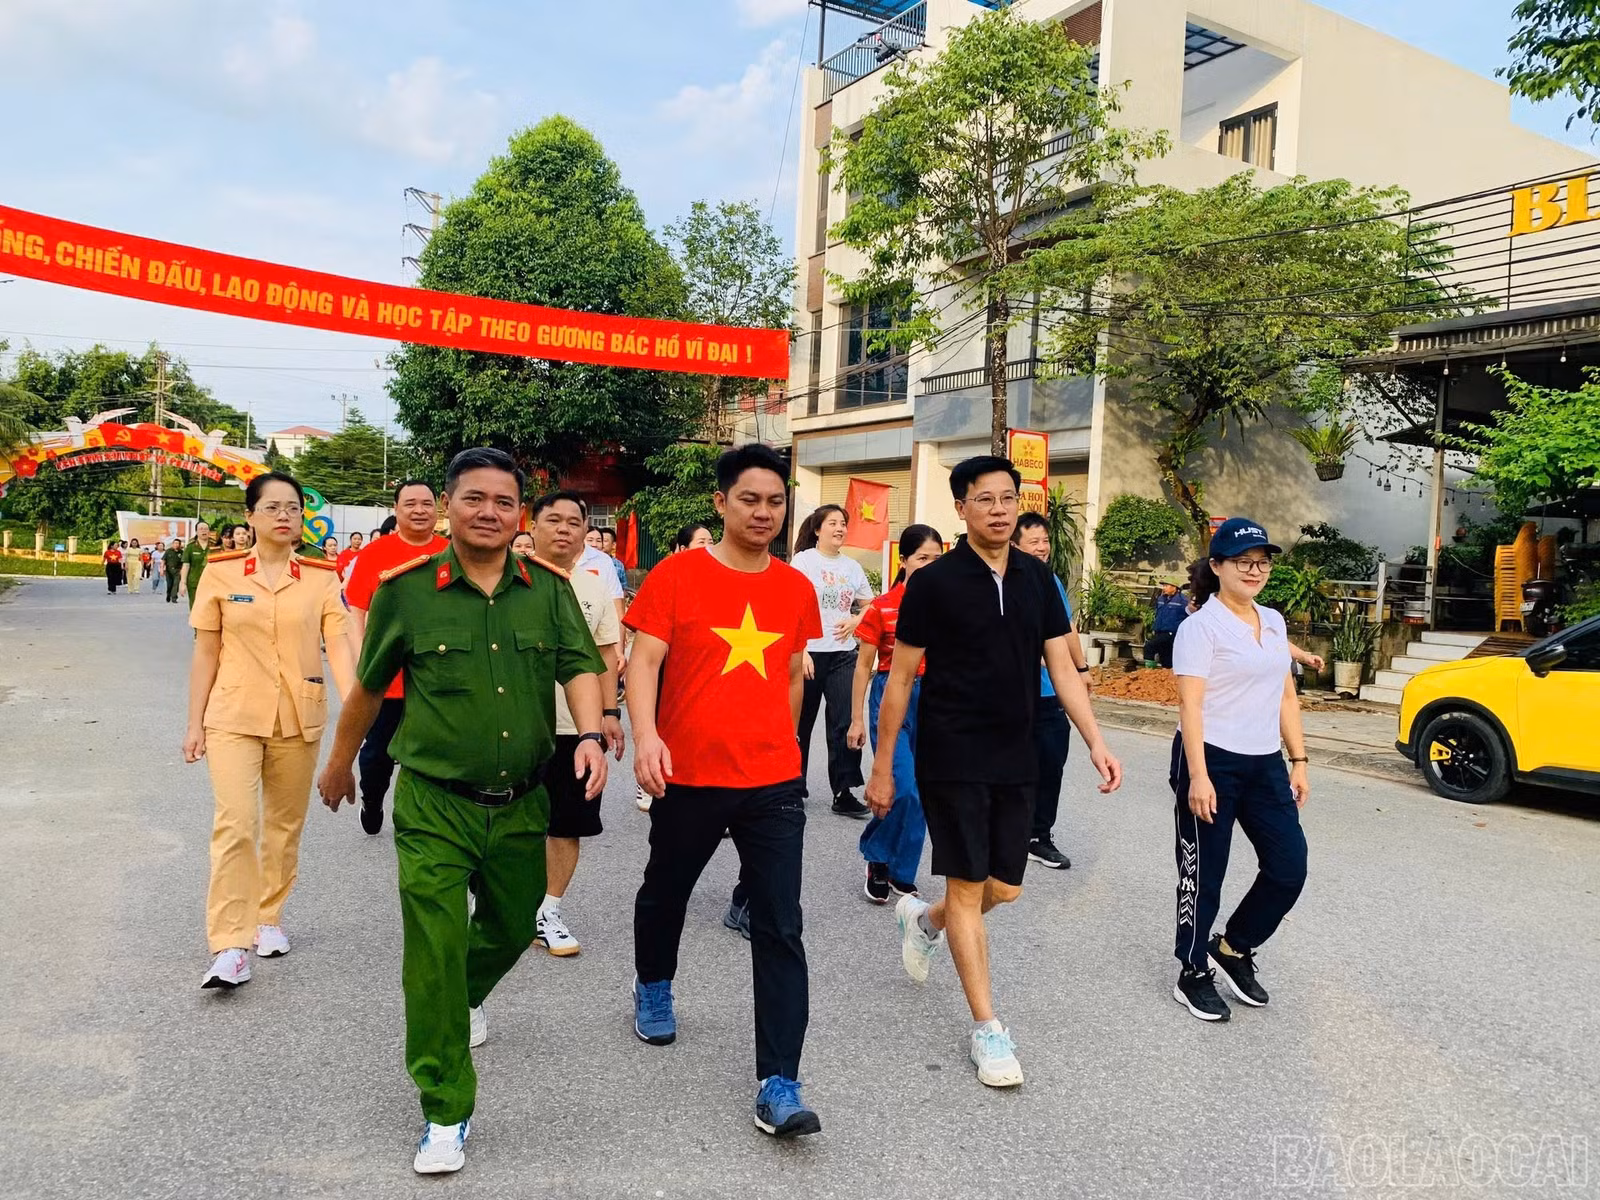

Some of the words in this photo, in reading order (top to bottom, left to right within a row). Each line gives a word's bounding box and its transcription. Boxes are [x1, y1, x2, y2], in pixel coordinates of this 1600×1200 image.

[0, 217, 50, 265] NG,
[55, 240, 140, 281] CHIẾN
[147, 260, 207, 296] ĐẤU,
[212, 272, 260, 303] LAO
[266, 281, 334, 315] ĐỘNG
[342, 293, 370, 321] VÀ
[377, 301, 423, 331] HỌC
[430, 307, 473, 337] TẬP
[480, 316, 531, 343] THEO
[537, 323, 606, 352] GƯƠNG
[611, 330, 649, 356] BÁC
[686, 336, 704, 360] VĨ
[707, 341, 738, 367] ĐẠI
[746, 344, 752, 364] !
[1013, 457, 1044, 470] HABECO
[1234, 526, 1263, 538] HUST
